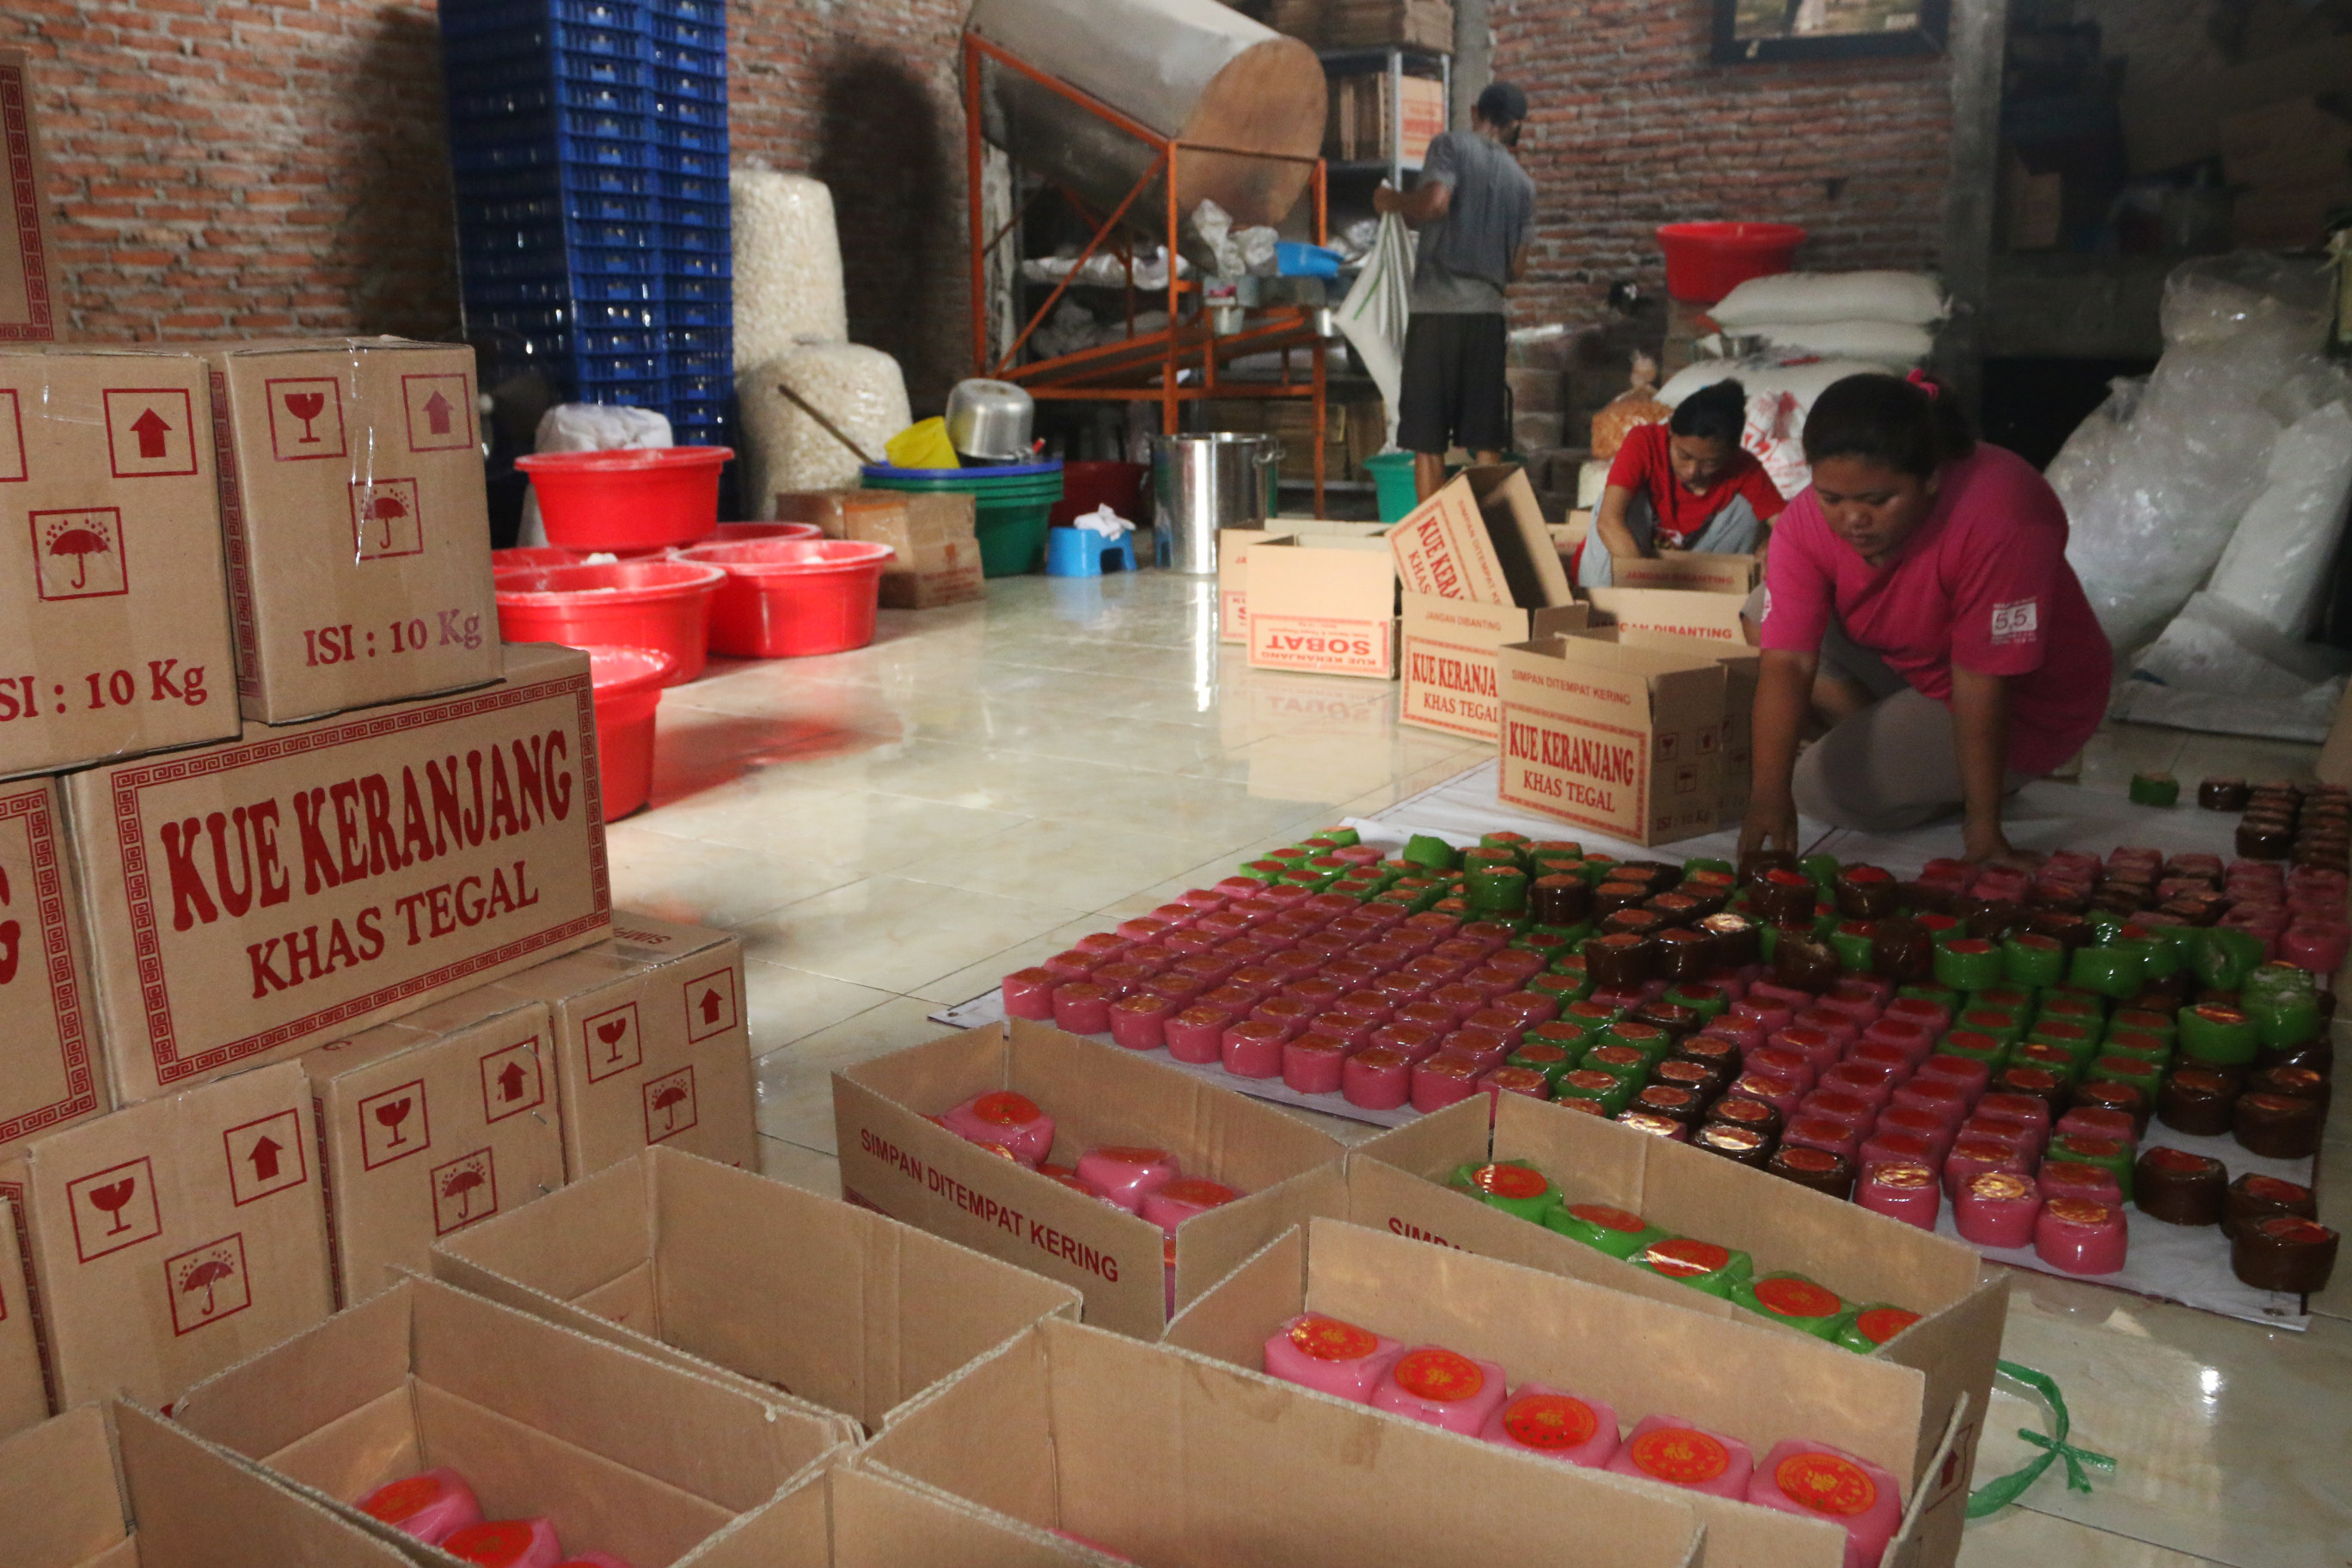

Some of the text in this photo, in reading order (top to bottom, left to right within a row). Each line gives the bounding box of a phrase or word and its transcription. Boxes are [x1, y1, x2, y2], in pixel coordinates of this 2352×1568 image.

[1408, 550, 1432, 595] KHAS
[1418, 516, 1465, 601] KUE KERA
[303, 624, 355, 666] ISI
[389, 619, 427, 653] 10
[437, 609, 481, 650] Kg
[1265, 634, 1370, 655] SOBAT
[85, 670, 135, 709] 10
[148, 658, 207, 706] Kg
[1412, 652, 1436, 685] KUE
[1511, 669, 1632, 705] SIMPAN DITEMPAT KERING
[1424, 693, 1455, 714] KHAS
[1510, 721, 1634, 787] KUE KERANJANG
[1523, 769, 1615, 812] KHAS TEGAL
[161, 797, 290, 932] KUE
[293, 729, 572, 896] KERANJANG
[247, 860, 539, 999] KHAS TEGAL
[613, 927, 672, 945] SIMP
[861, 1128, 1118, 1282] SIMPAN DITEMPAT KERING
